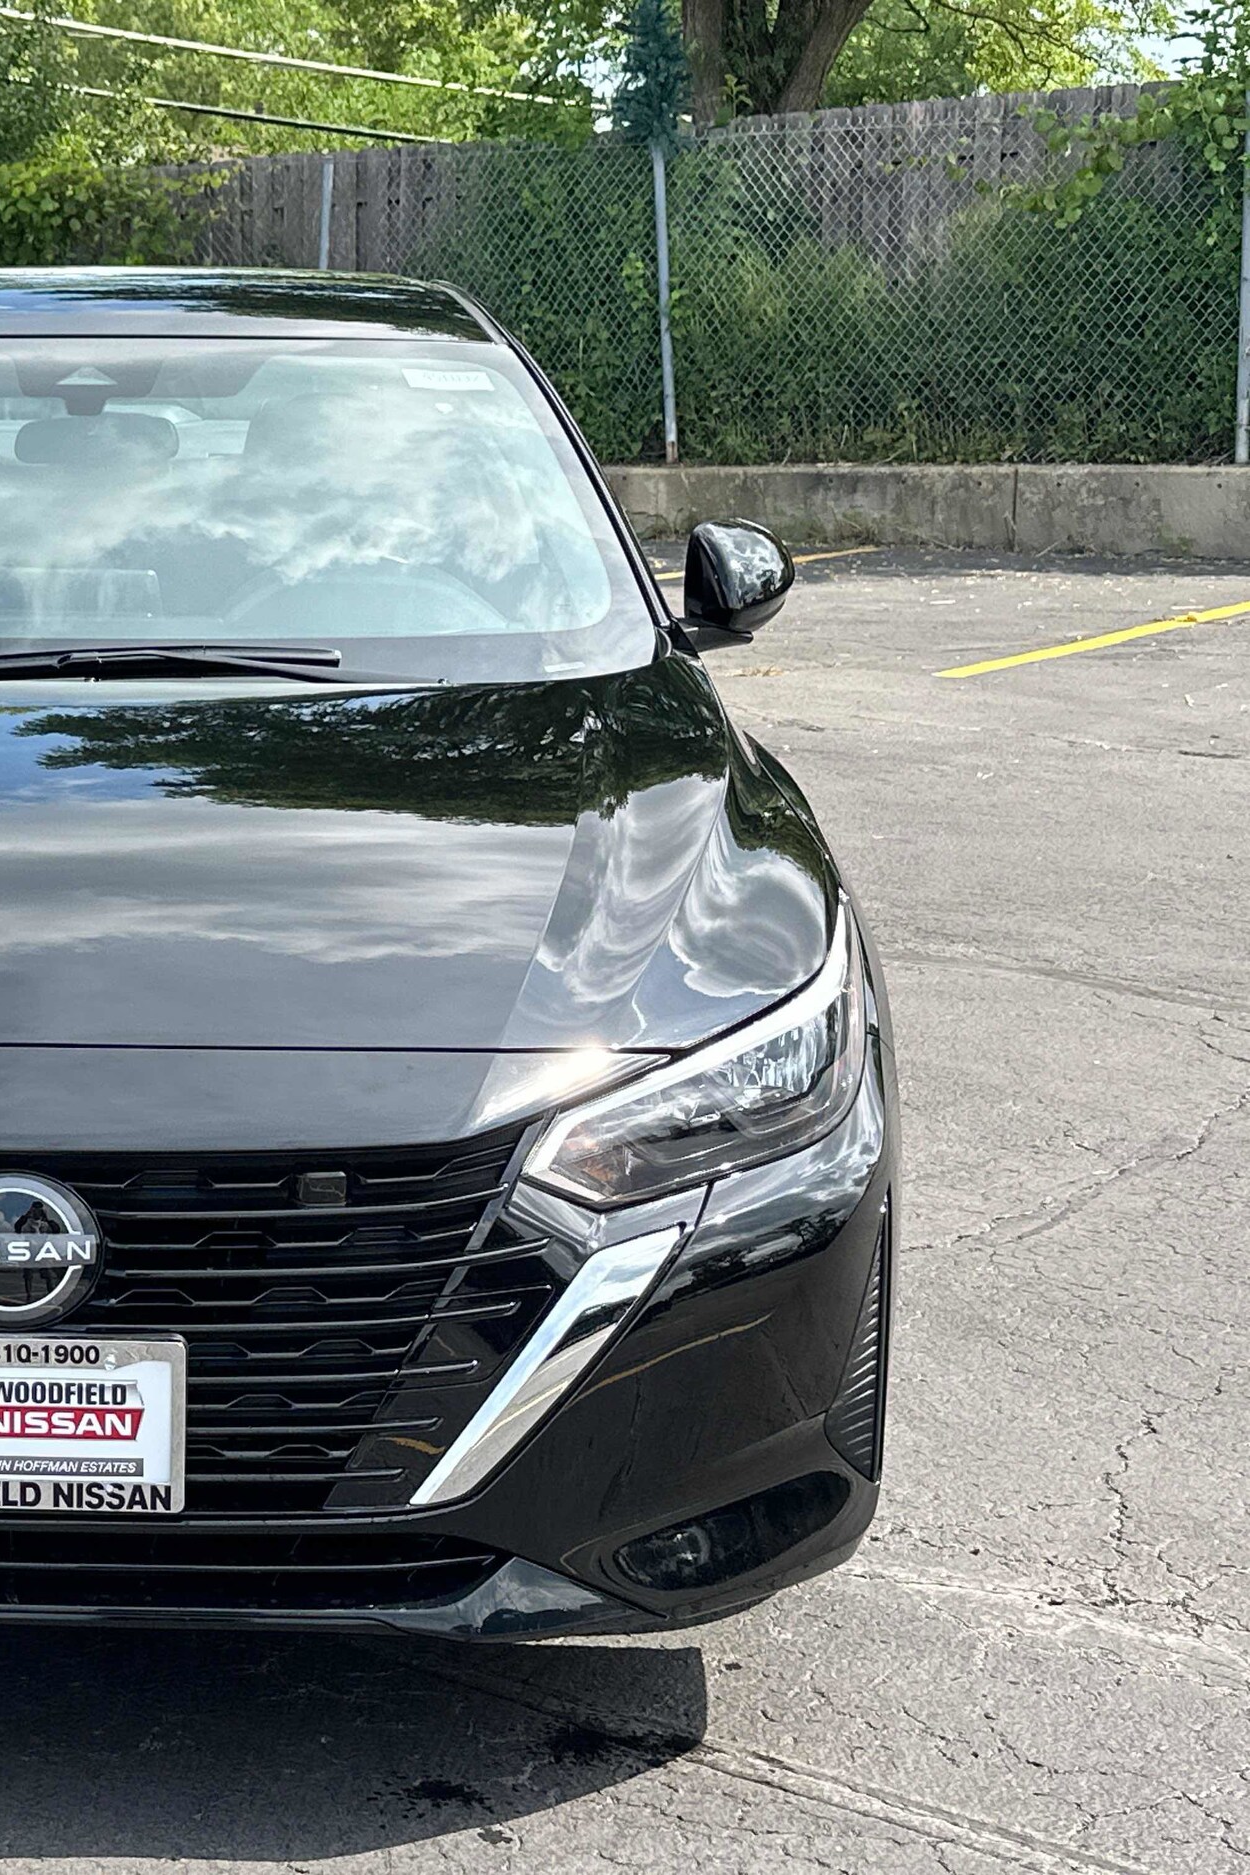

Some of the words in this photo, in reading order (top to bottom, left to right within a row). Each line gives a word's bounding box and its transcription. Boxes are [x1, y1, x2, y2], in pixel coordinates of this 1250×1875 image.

[13, 1460, 79, 1473] HOFFMAN
[80, 1461, 137, 1474] ESTATES
[53, 1482, 171, 1511] NISSAN
